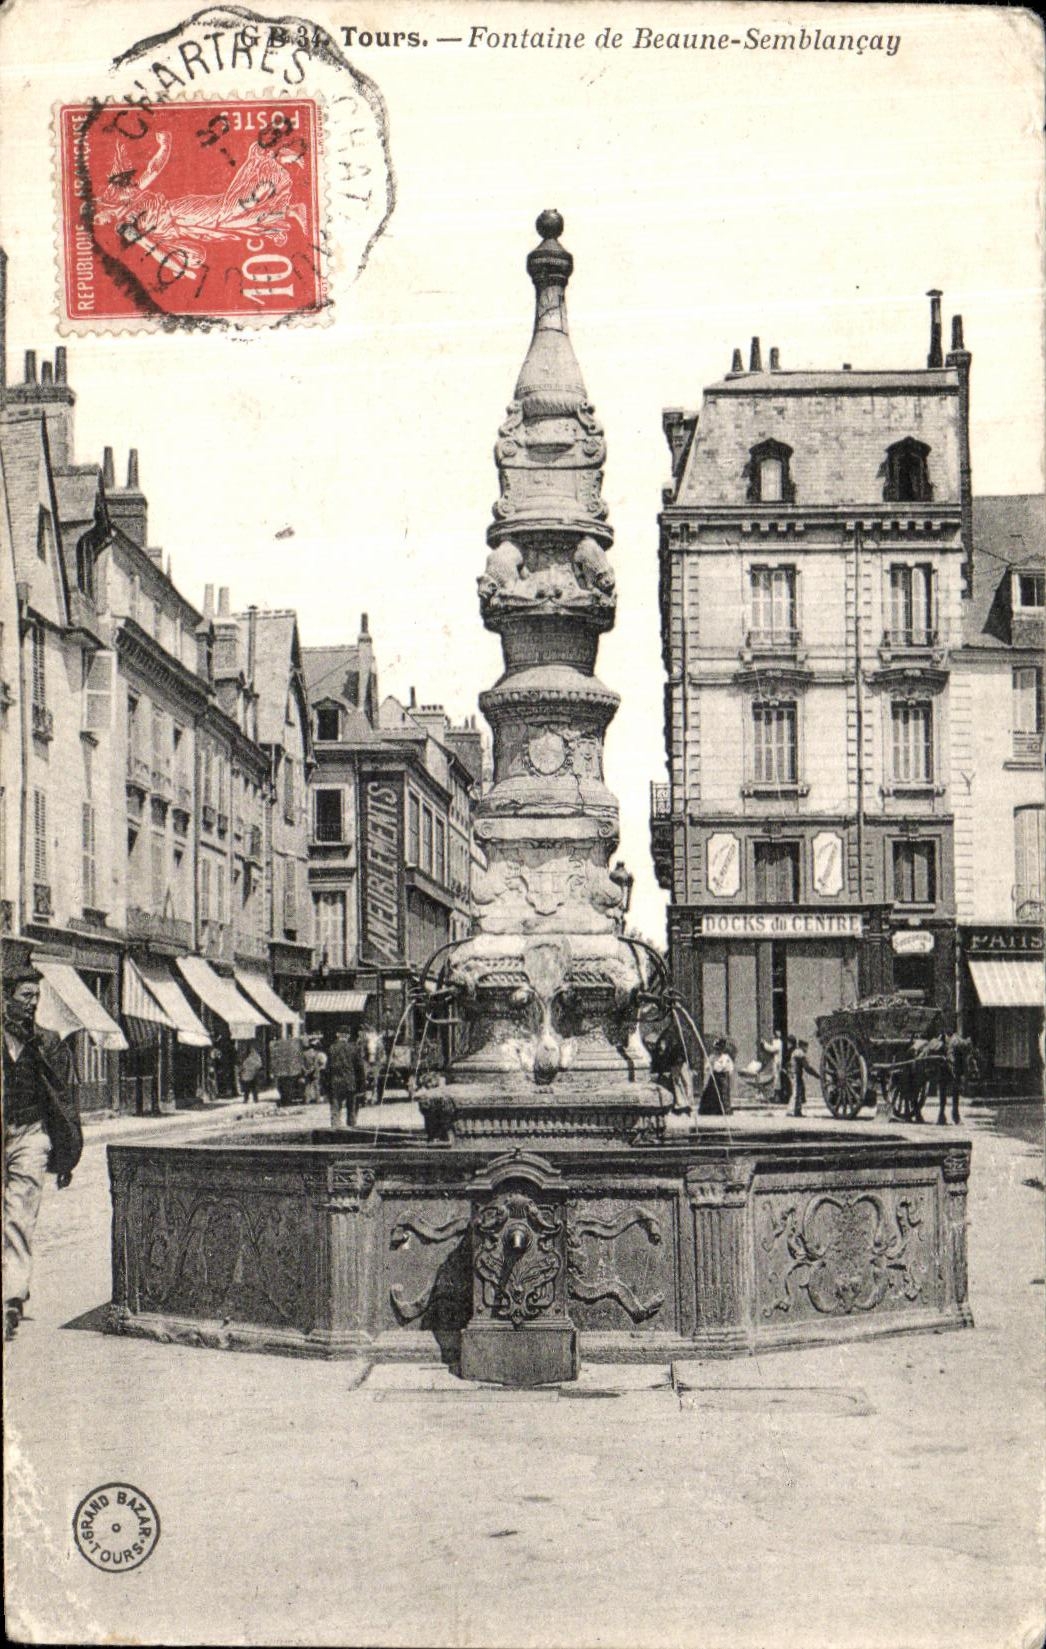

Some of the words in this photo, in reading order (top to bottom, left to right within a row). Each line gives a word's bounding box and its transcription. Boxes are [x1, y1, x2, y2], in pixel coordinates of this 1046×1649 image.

[366, 781, 398, 964] AMEUBLEMENTS
[705, 915, 766, 932] DOCKS
[770, 916, 787, 932] du
[792, 914, 860, 932] CENTRE
